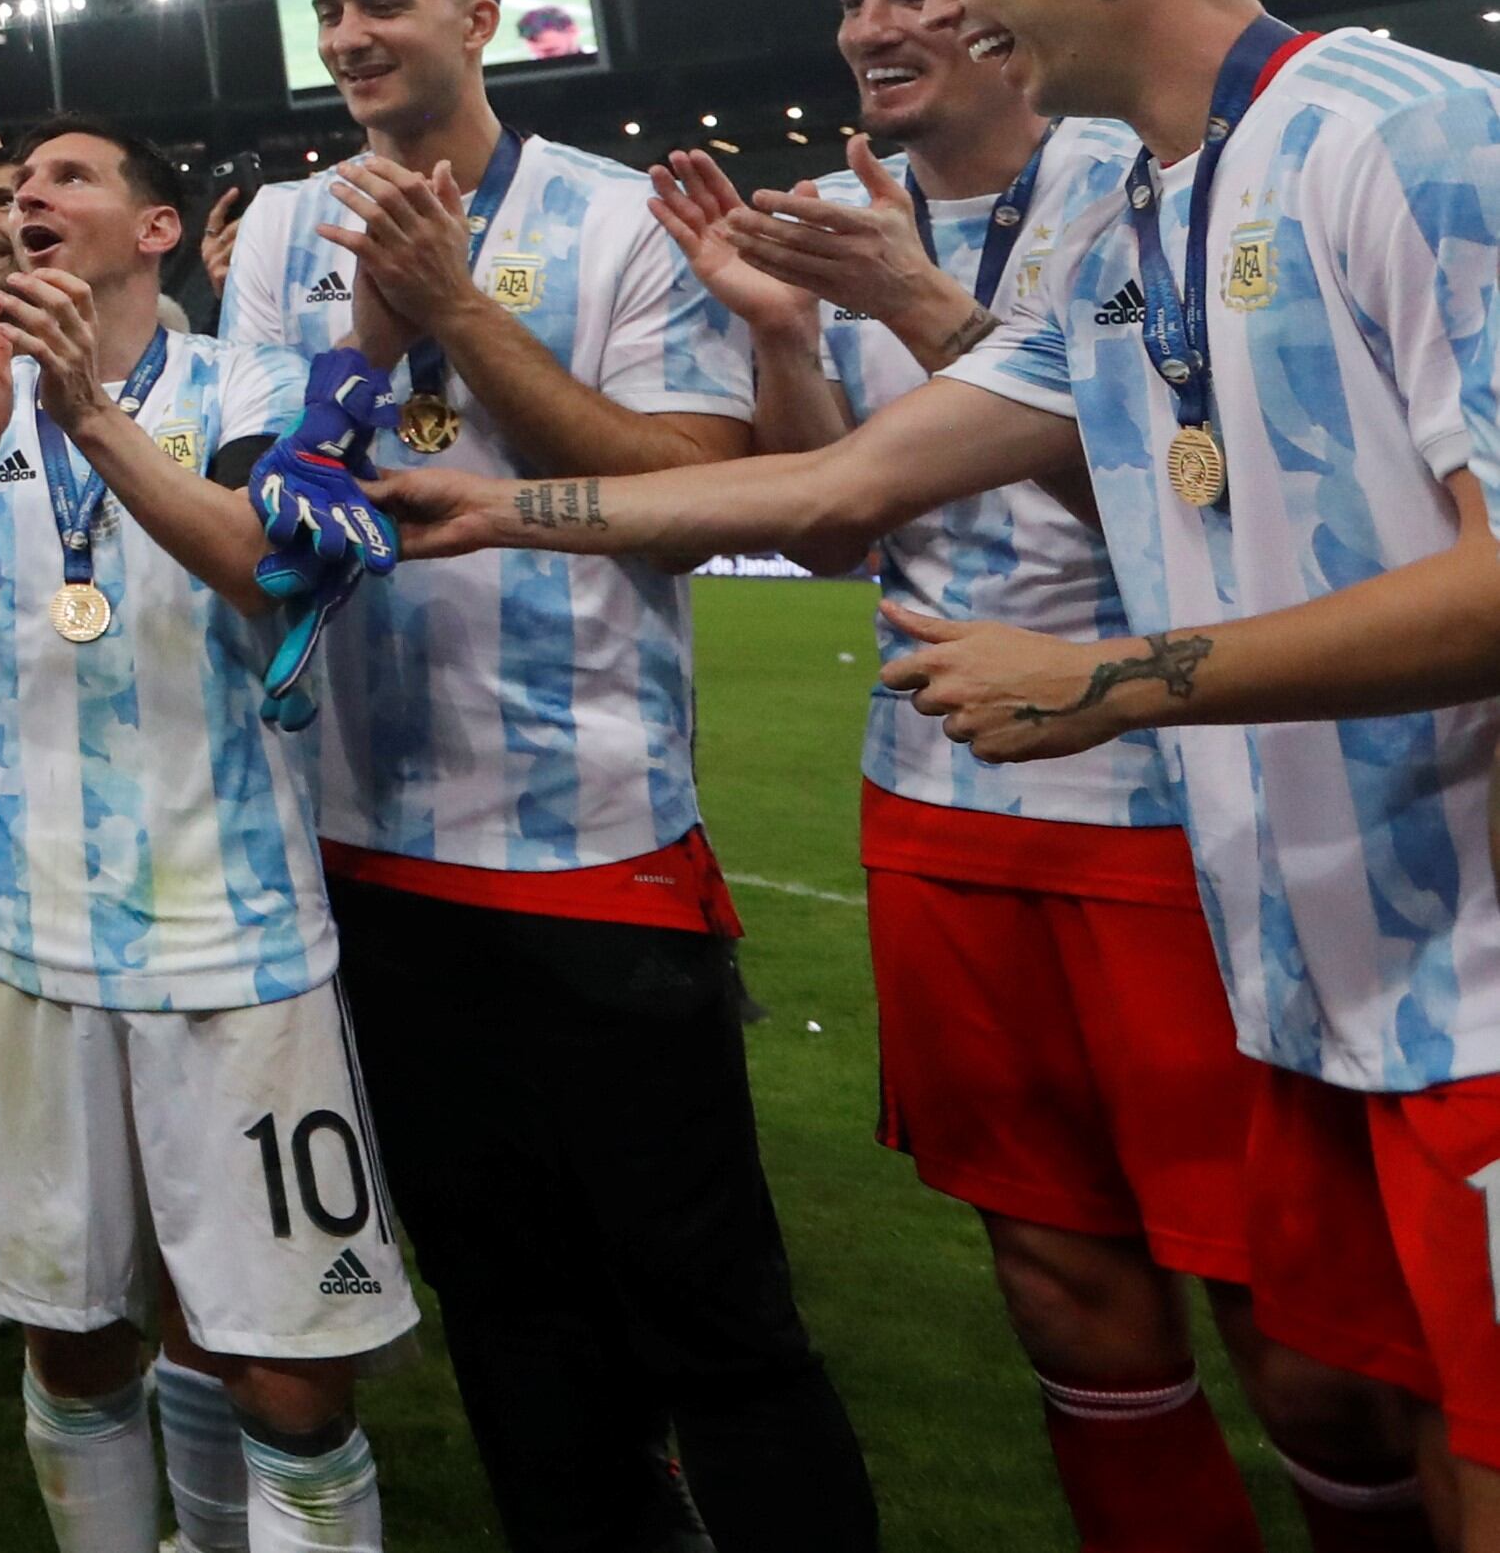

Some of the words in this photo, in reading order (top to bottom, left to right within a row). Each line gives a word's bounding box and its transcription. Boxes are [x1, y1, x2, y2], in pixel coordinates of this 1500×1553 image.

[1232, 244, 1263, 287] AFA
[306, 287, 352, 303] adidas
[496, 268, 529, 298] AFA
[161, 434, 192, 462] AFA
[352, 505, 391, 558] reusch
[709, 554, 735, 576] de
[243, 1109, 370, 1239] 10
[319, 1278, 383, 1295] adidas
